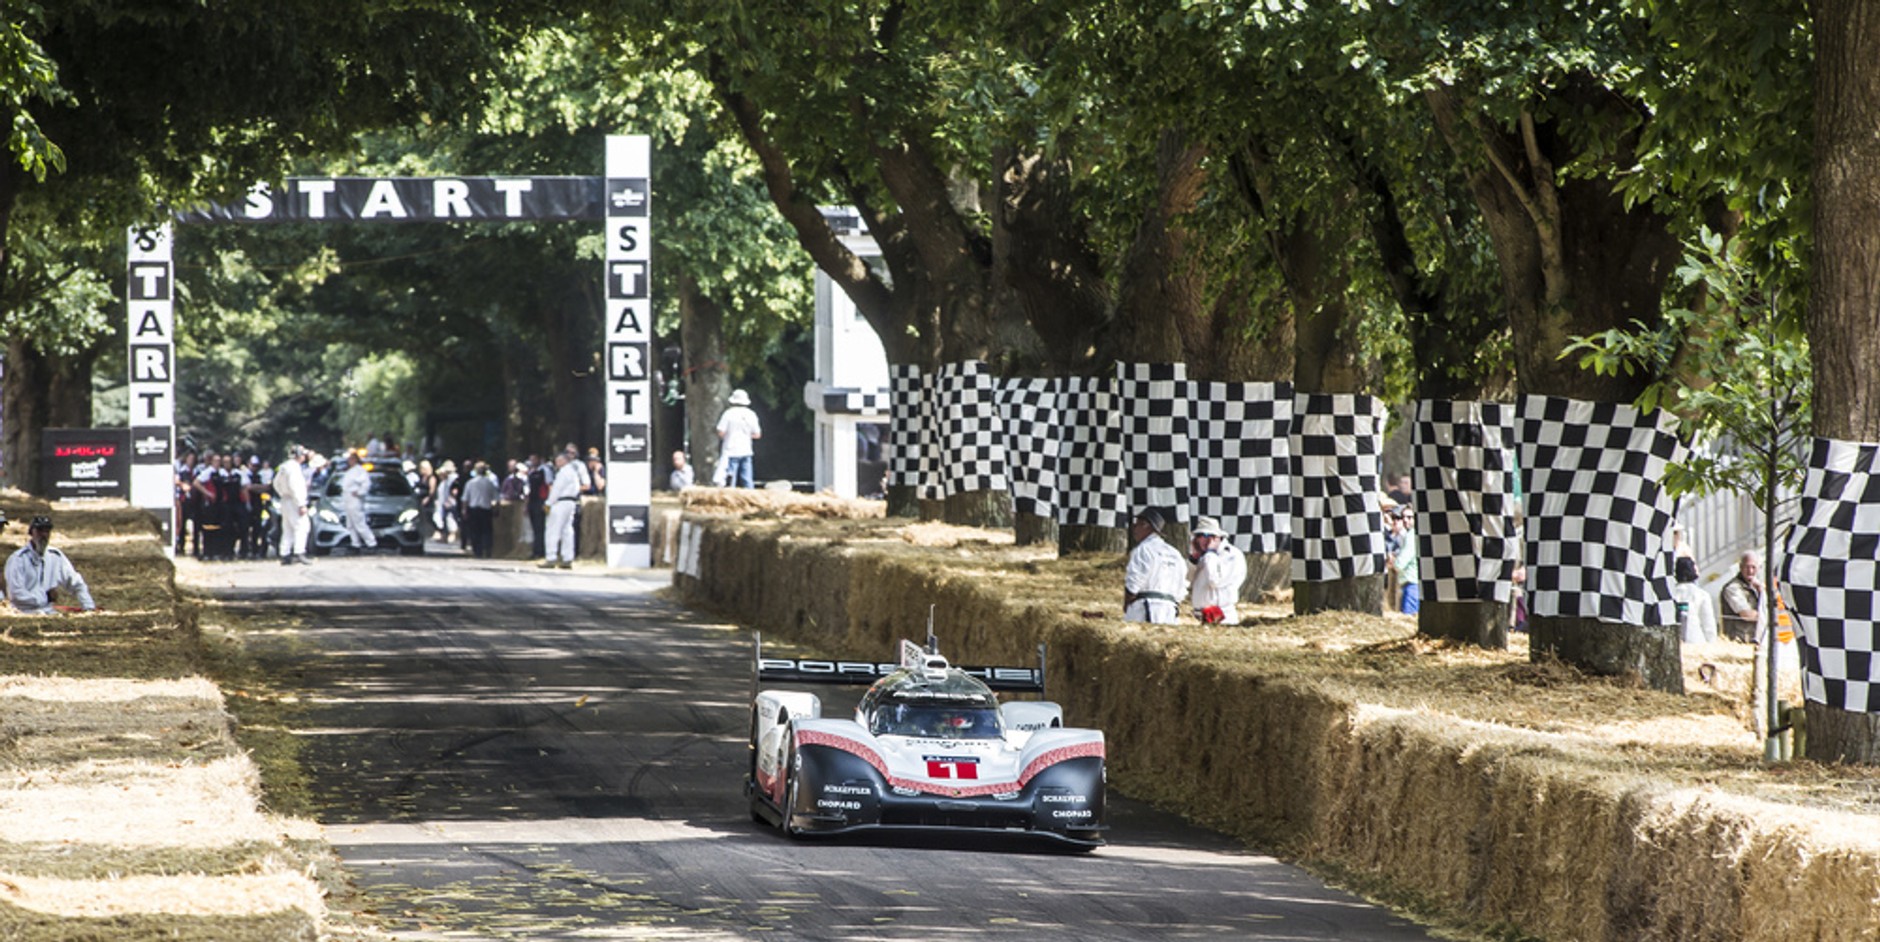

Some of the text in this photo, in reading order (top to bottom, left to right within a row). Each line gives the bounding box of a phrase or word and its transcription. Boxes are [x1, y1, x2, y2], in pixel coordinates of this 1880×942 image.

[244, 179, 533, 219] START
[134, 224, 168, 419] START
[612, 225, 644, 415] START
[939, 762, 959, 779] 1
[817, 799, 861, 810] CHOPARD
[1052, 809, 1092, 818] CHOPARD
